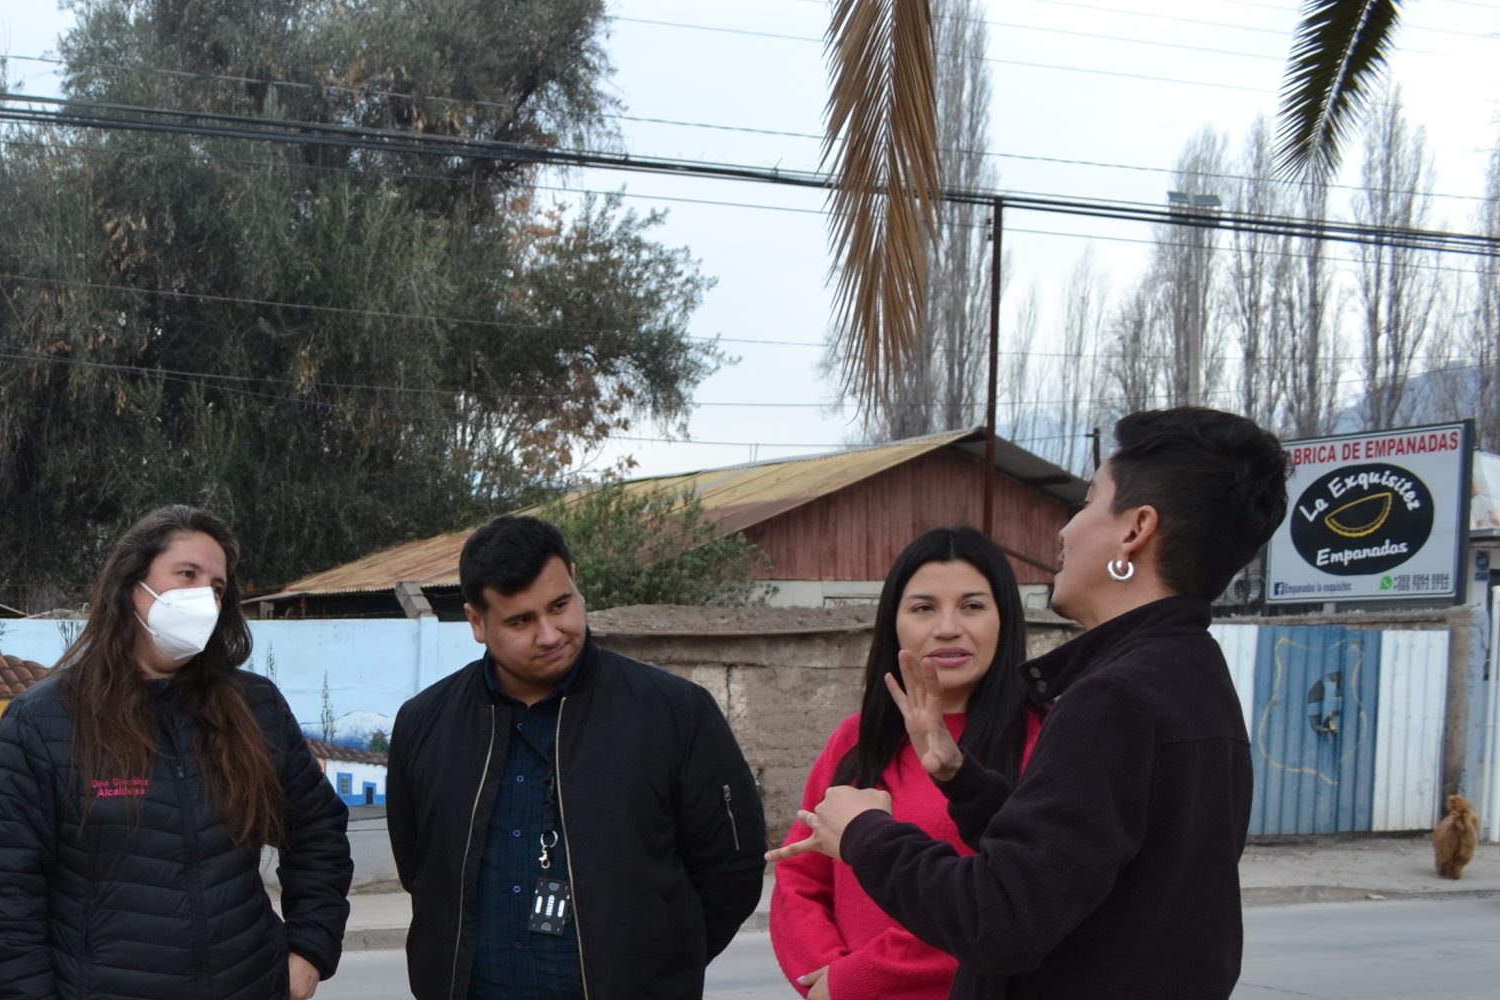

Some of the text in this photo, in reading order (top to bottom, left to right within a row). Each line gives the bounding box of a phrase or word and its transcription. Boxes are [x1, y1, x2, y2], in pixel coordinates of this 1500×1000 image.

[1342, 442, 1360, 461] DE
[1365, 431, 1459, 459] EMPANADAS
[1299, 470, 1421, 523] La Exquisitez
[1315, 538, 1409, 567] Empanadas
